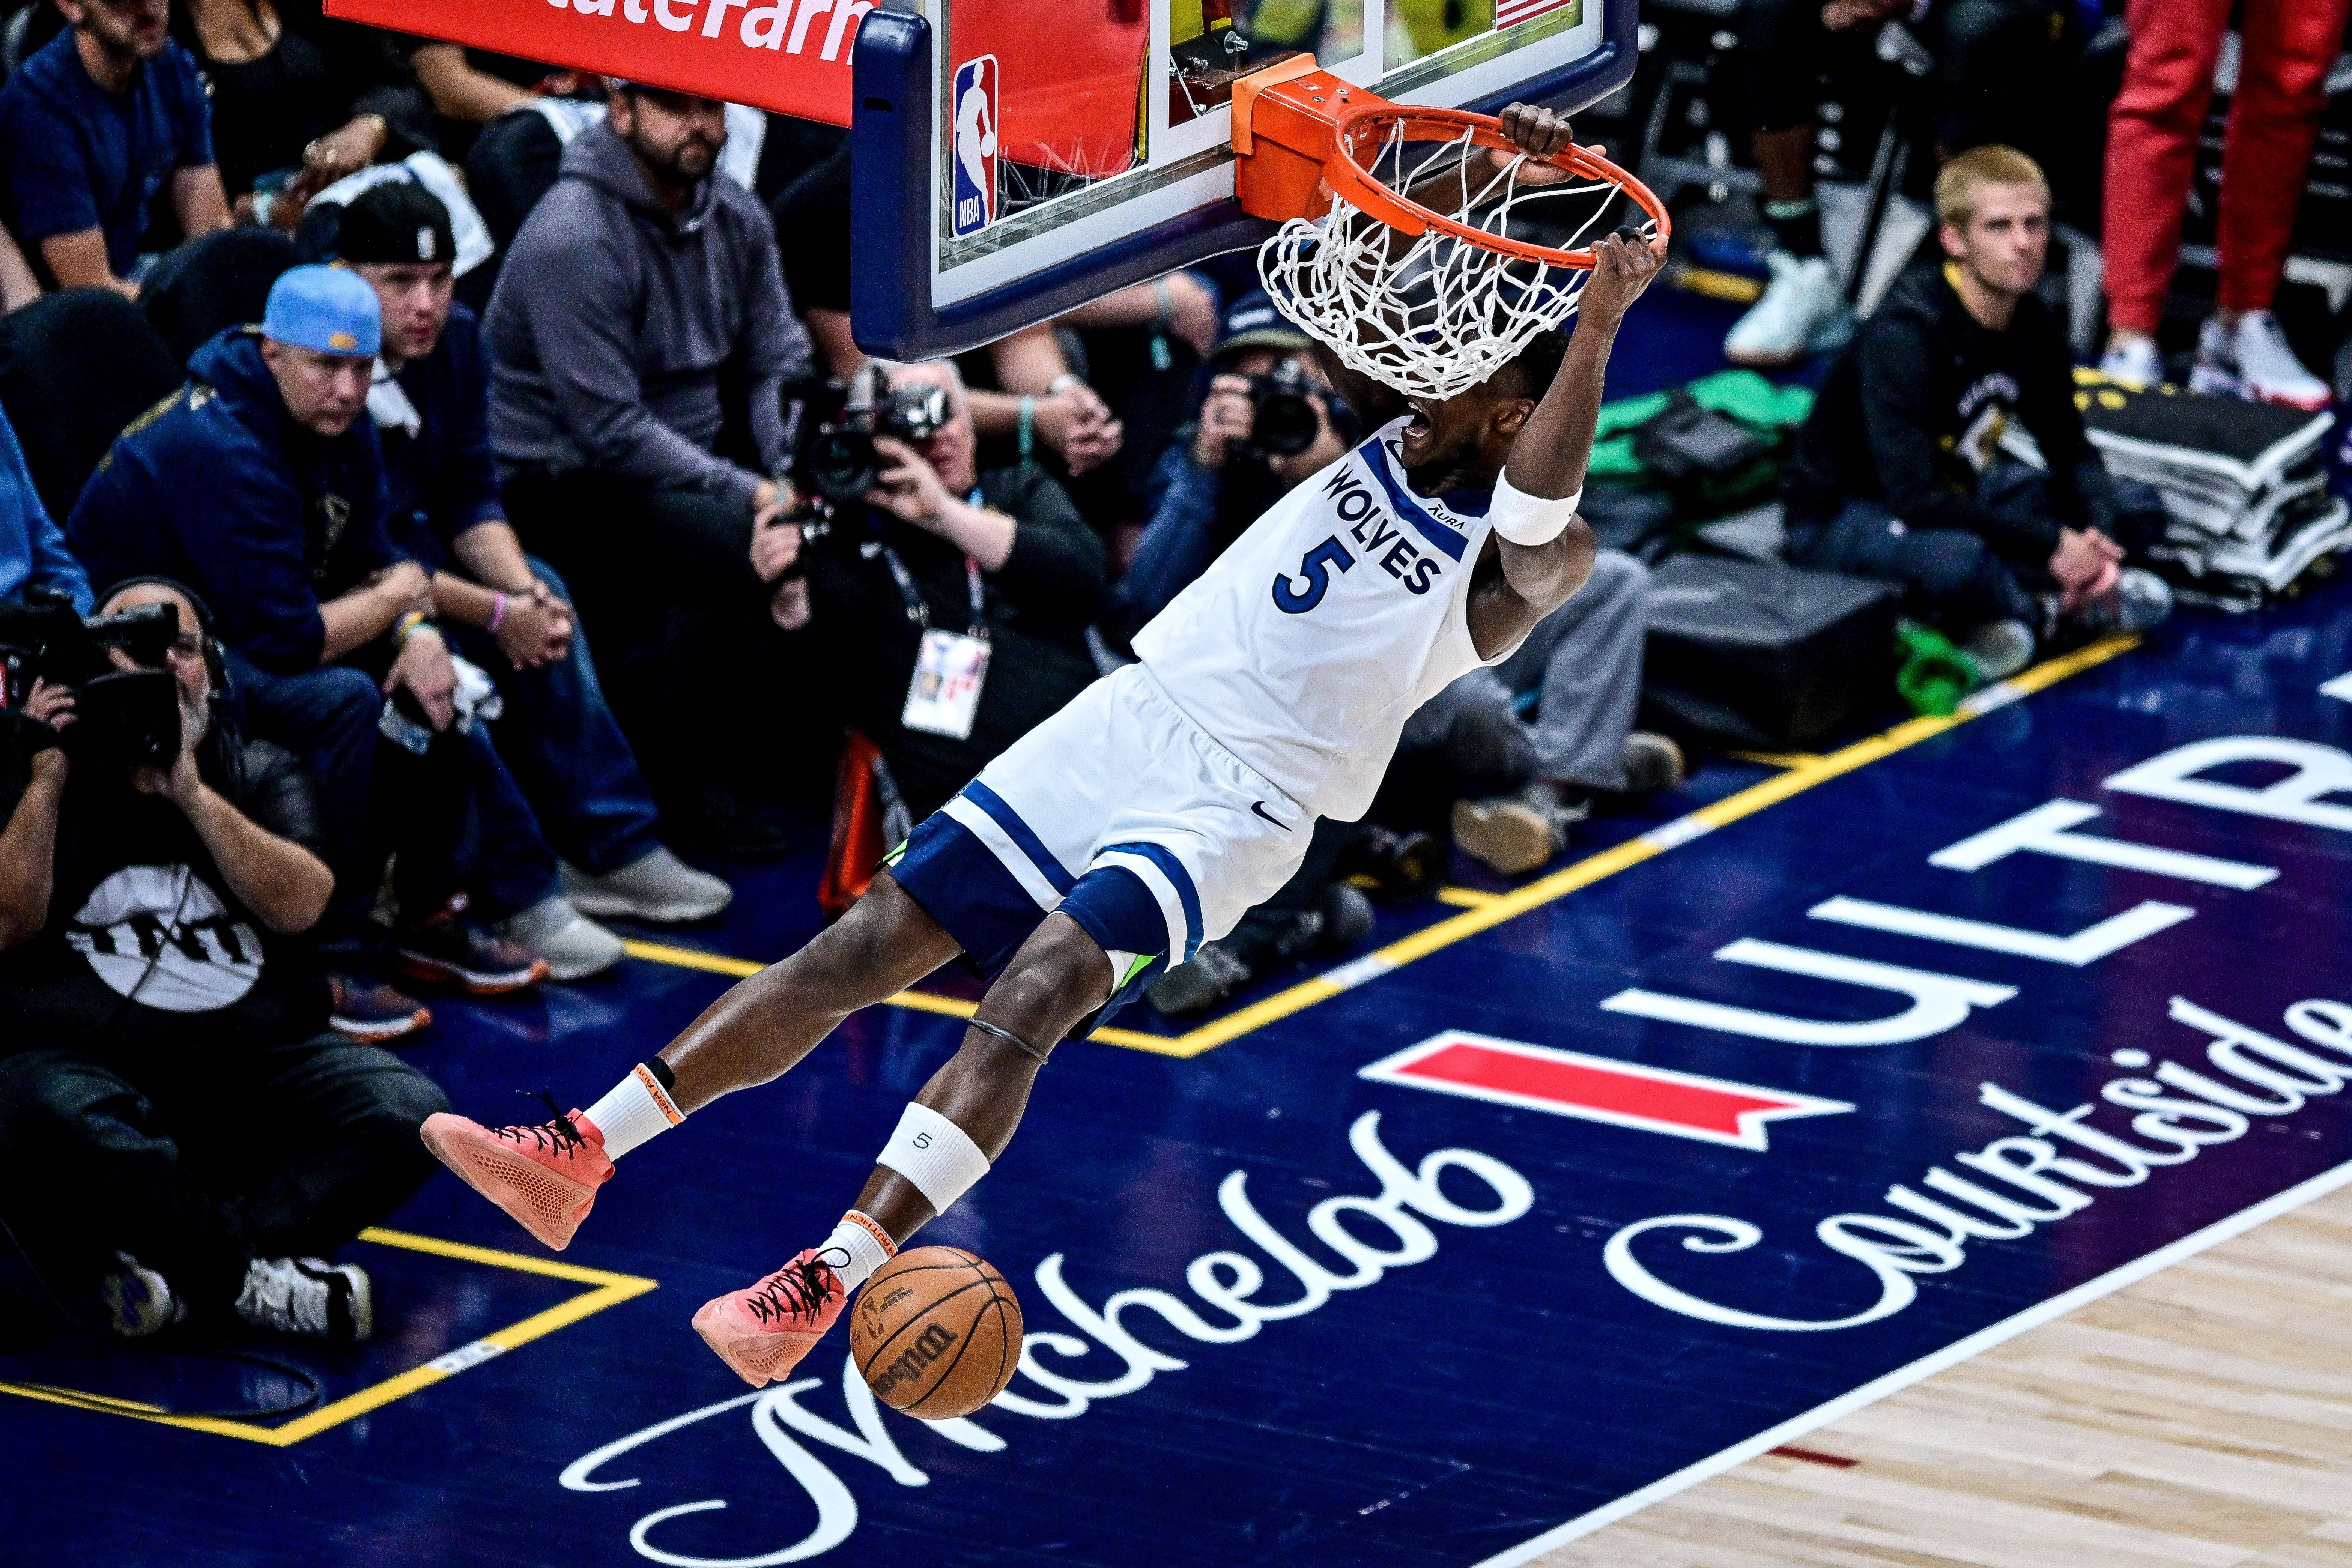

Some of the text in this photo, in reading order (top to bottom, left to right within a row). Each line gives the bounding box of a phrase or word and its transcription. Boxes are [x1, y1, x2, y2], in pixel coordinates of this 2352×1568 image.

[959, 195, 980, 228] NBA
[1321, 462, 1441, 595] WOLVES
[1272, 534, 1356, 614] 5
[1599, 674, 2352, 1046] ULTR
[653, 1091, 672, 1114] NBA
[913, 1132, 932, 1149] 5
[869, 1322, 958, 1396] Wilson
